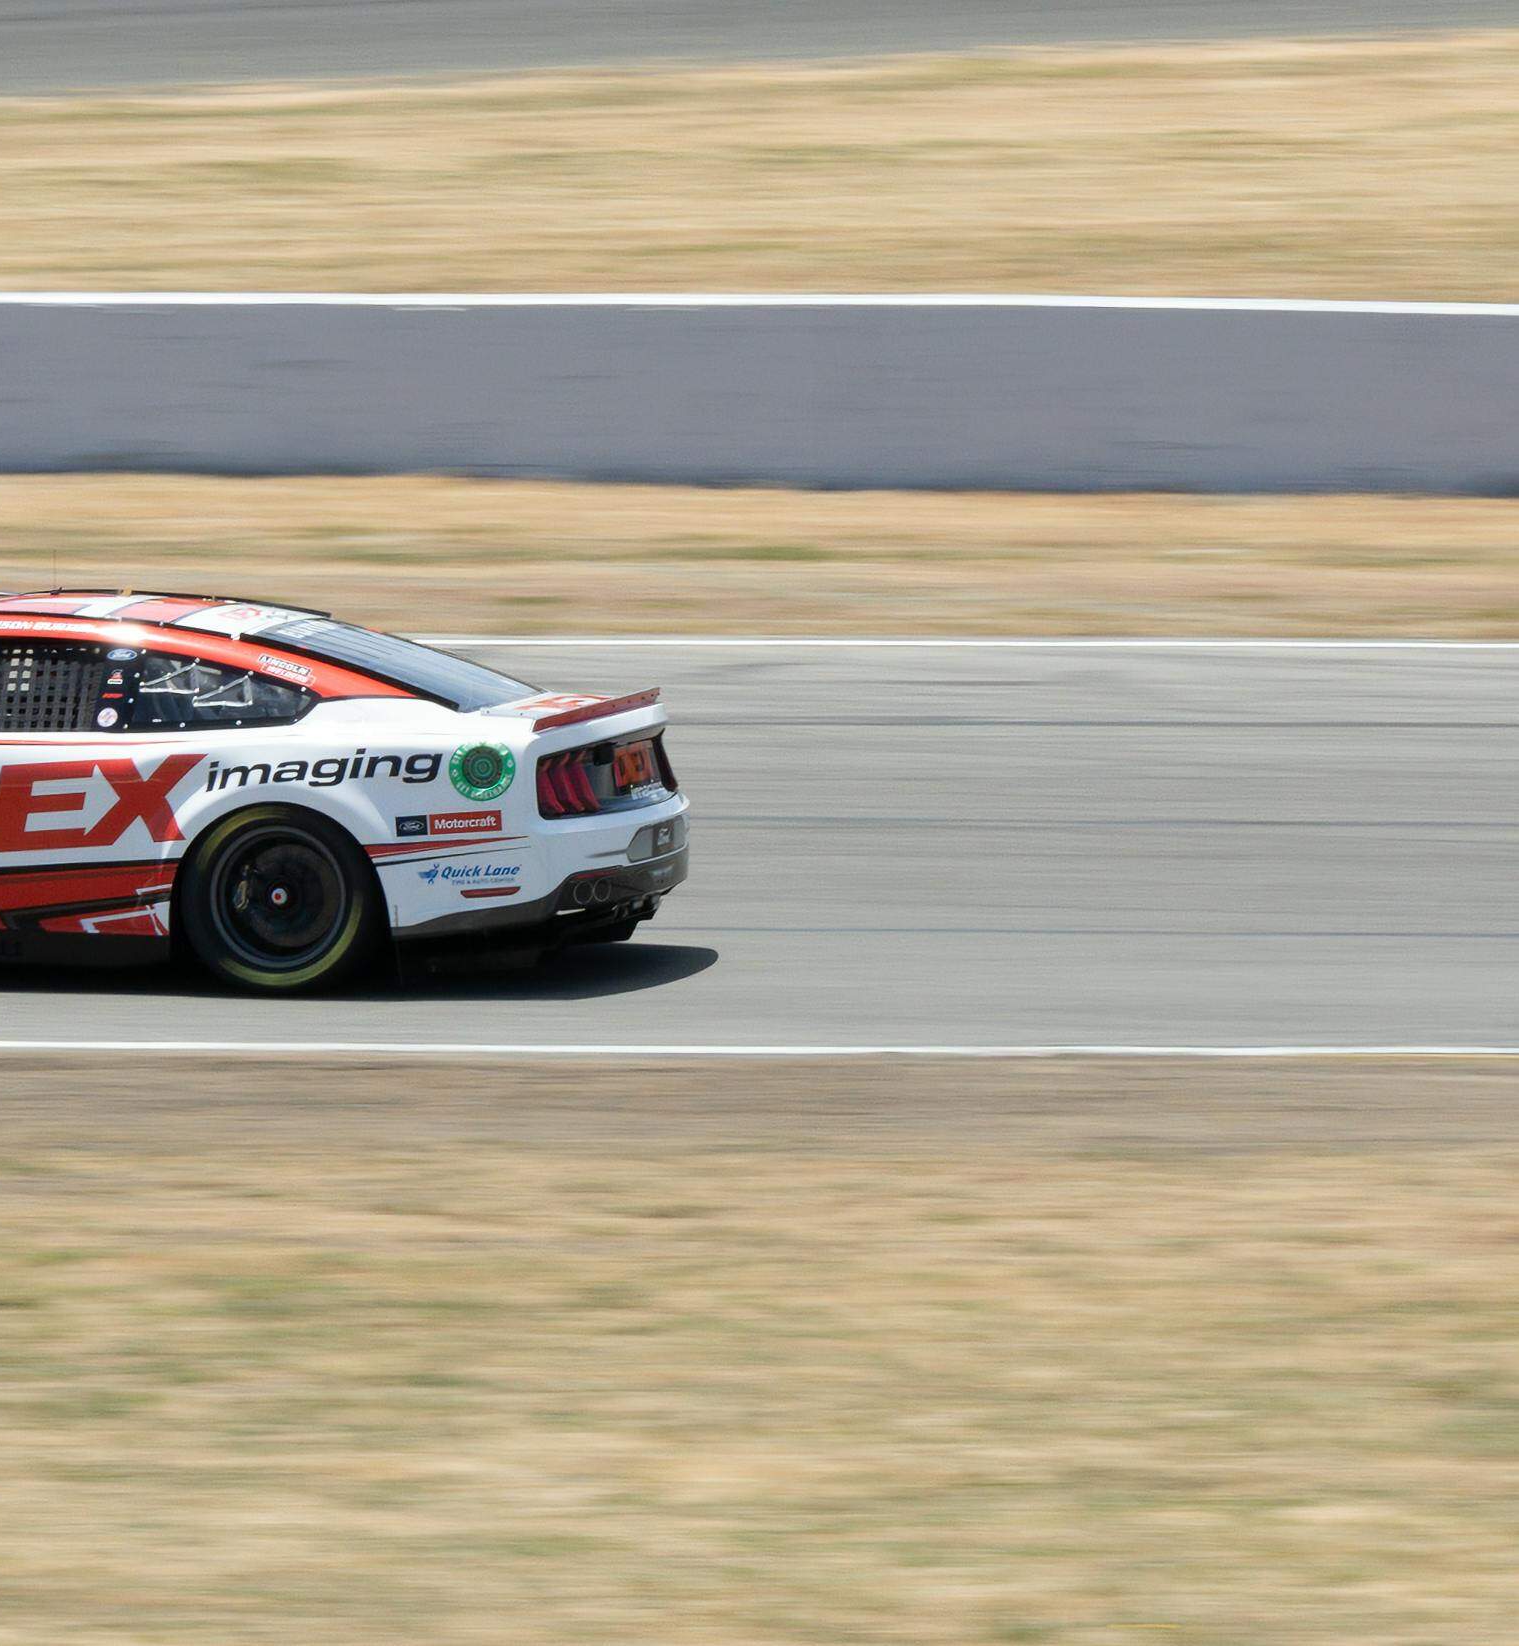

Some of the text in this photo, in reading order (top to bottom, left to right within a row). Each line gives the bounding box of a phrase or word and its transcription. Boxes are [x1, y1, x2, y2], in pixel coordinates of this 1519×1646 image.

[205, 748, 442, 791] imaging
[434, 815, 497, 830] Motorcraft
[441, 864, 521, 879] Quick Lane
